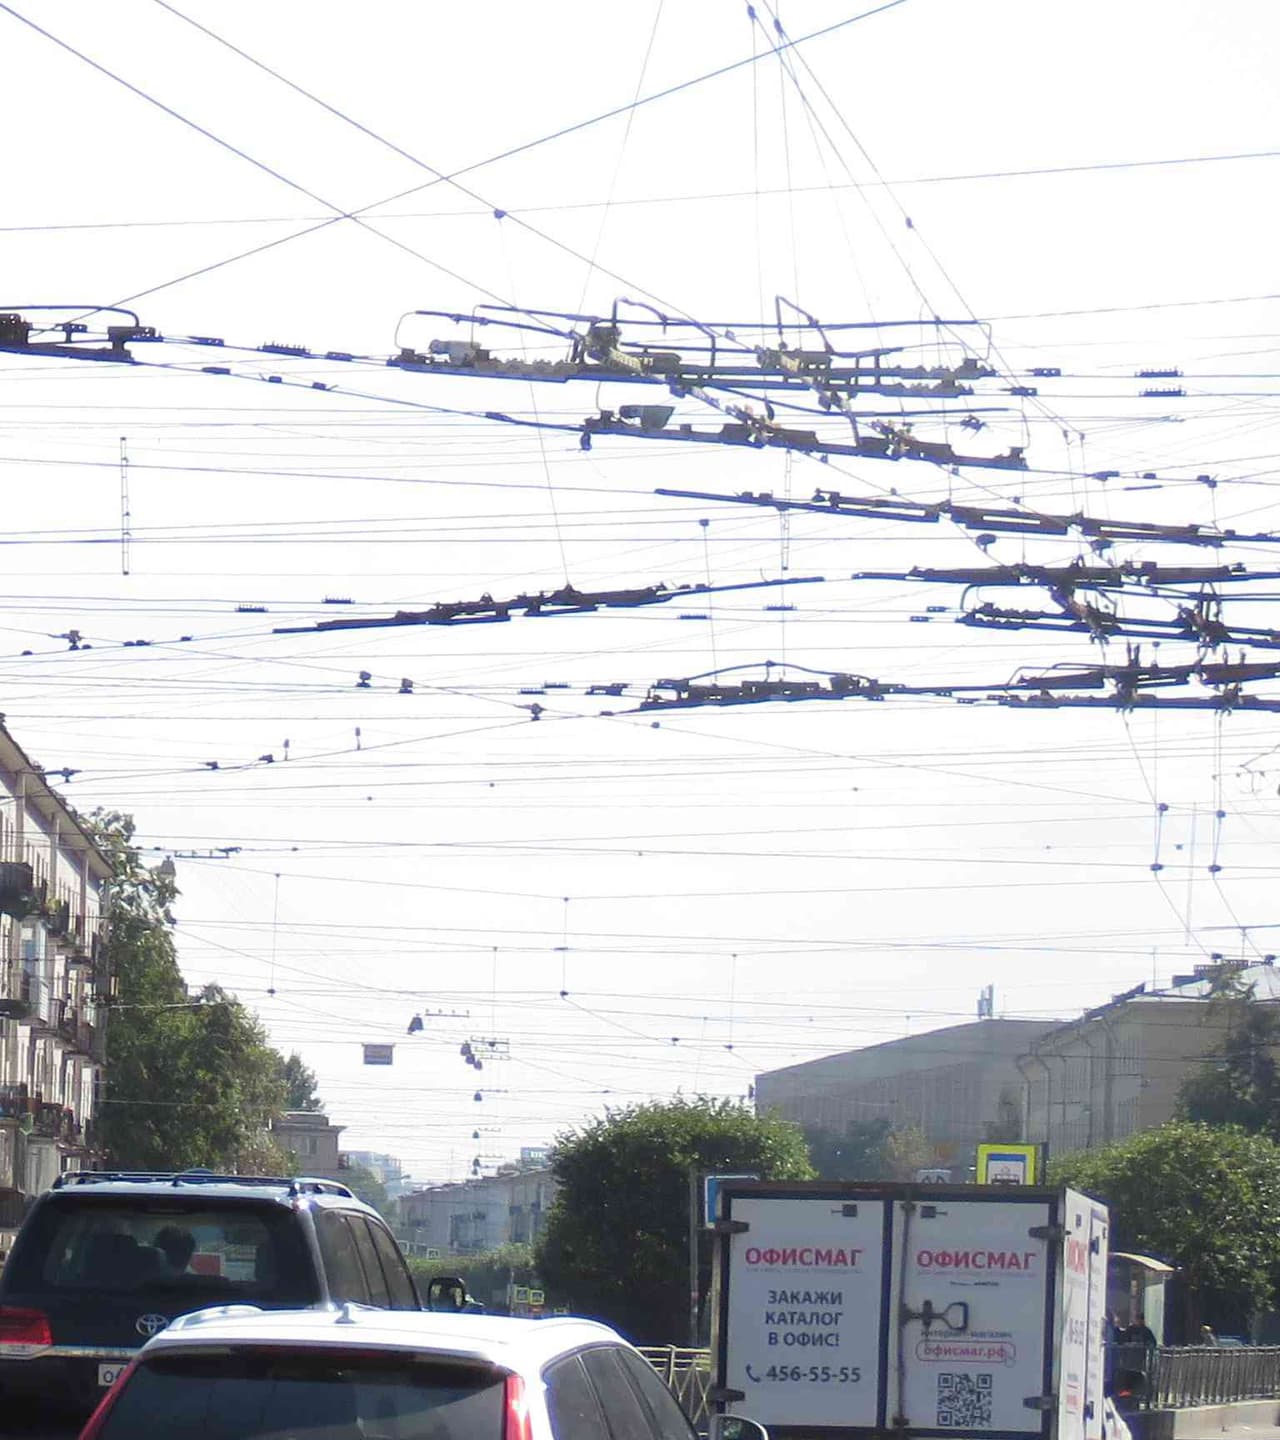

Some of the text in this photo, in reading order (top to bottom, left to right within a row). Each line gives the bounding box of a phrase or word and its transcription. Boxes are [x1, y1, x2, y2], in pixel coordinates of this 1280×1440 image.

[745, 1247, 864, 1267] ОФИСМАГ
[917, 1250, 1037, 1270] ОФИСМАГ
[768, 1290, 843, 1305] ЗАКАЖИ
[765, 1311, 844, 1326] КАТАЛОГ
[768, 1332, 840, 1347] В ОФИС!
[766, 1365, 862, 1383] 456-55-55
